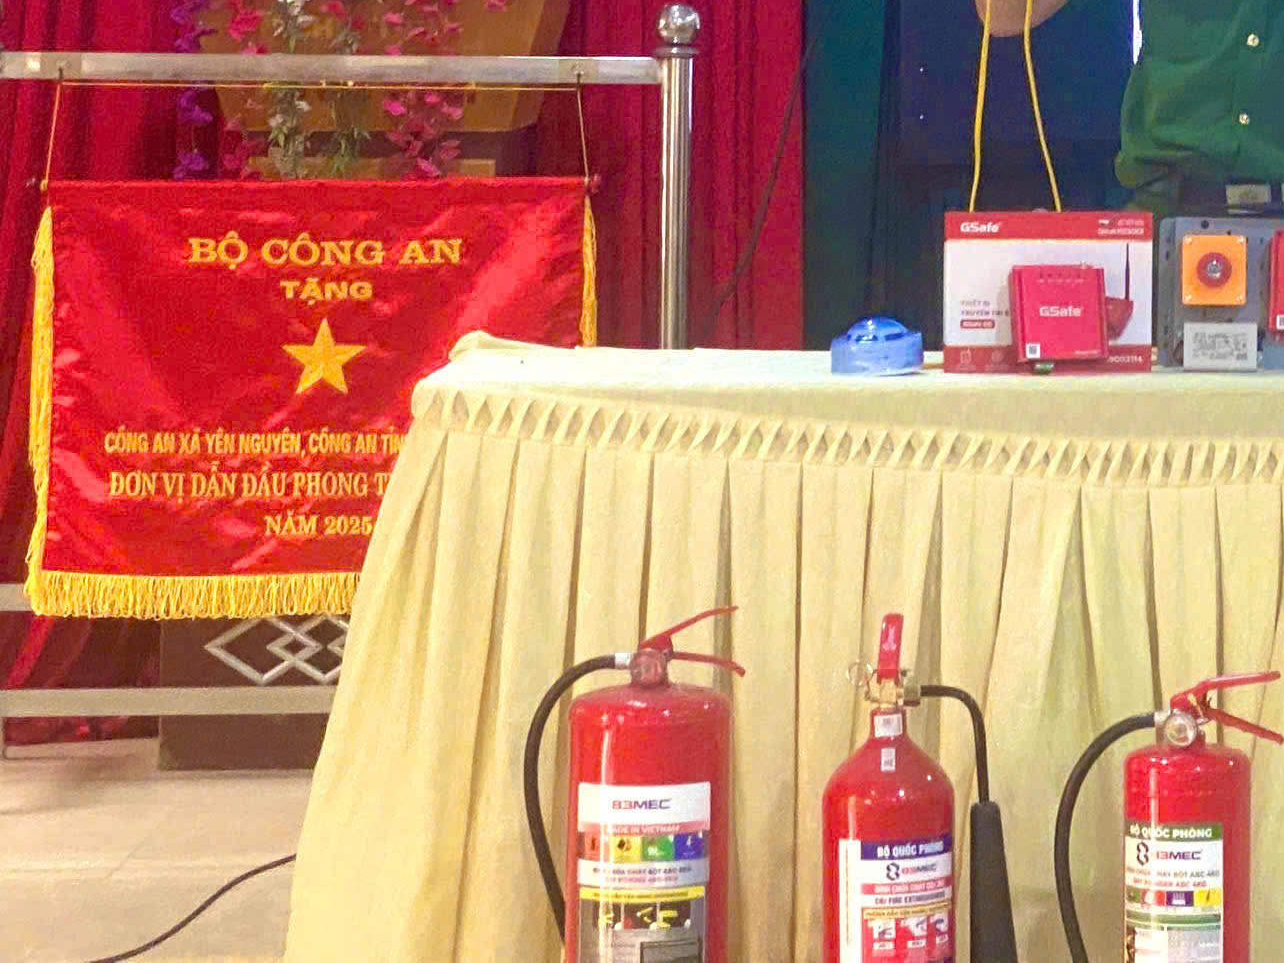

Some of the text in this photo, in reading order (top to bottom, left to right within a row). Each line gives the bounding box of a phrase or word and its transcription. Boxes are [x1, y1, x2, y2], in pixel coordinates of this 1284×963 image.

[960, 221, 999, 234] GSafe
[188, 230, 464, 270] BỘ CÔNG AN
[280, 277, 374, 305] TẶNG
[1039, 305, 1082, 318] GSafe
[104, 426, 149, 455] CÔNG
[152, 433, 176, 454] AN
[179, 426, 200, 454] XÃ
[206, 427, 235, 454] YÊN
[239, 428, 307, 458] NGUYÊN,
[309, 428, 352, 455] CÔNG
[355, 433, 376, 455] AN
[110, 470, 160, 497] ĐƠN
[161, 471, 185, 504] VỊ
[191, 461, 236, 498] DẪN
[242, 461, 288, 498] ĐẦU
[293, 471, 368, 497] PHONG
[264, 510, 373, 535] NĂM 2025
[1173, 827, 1213, 839] PHÒNG
